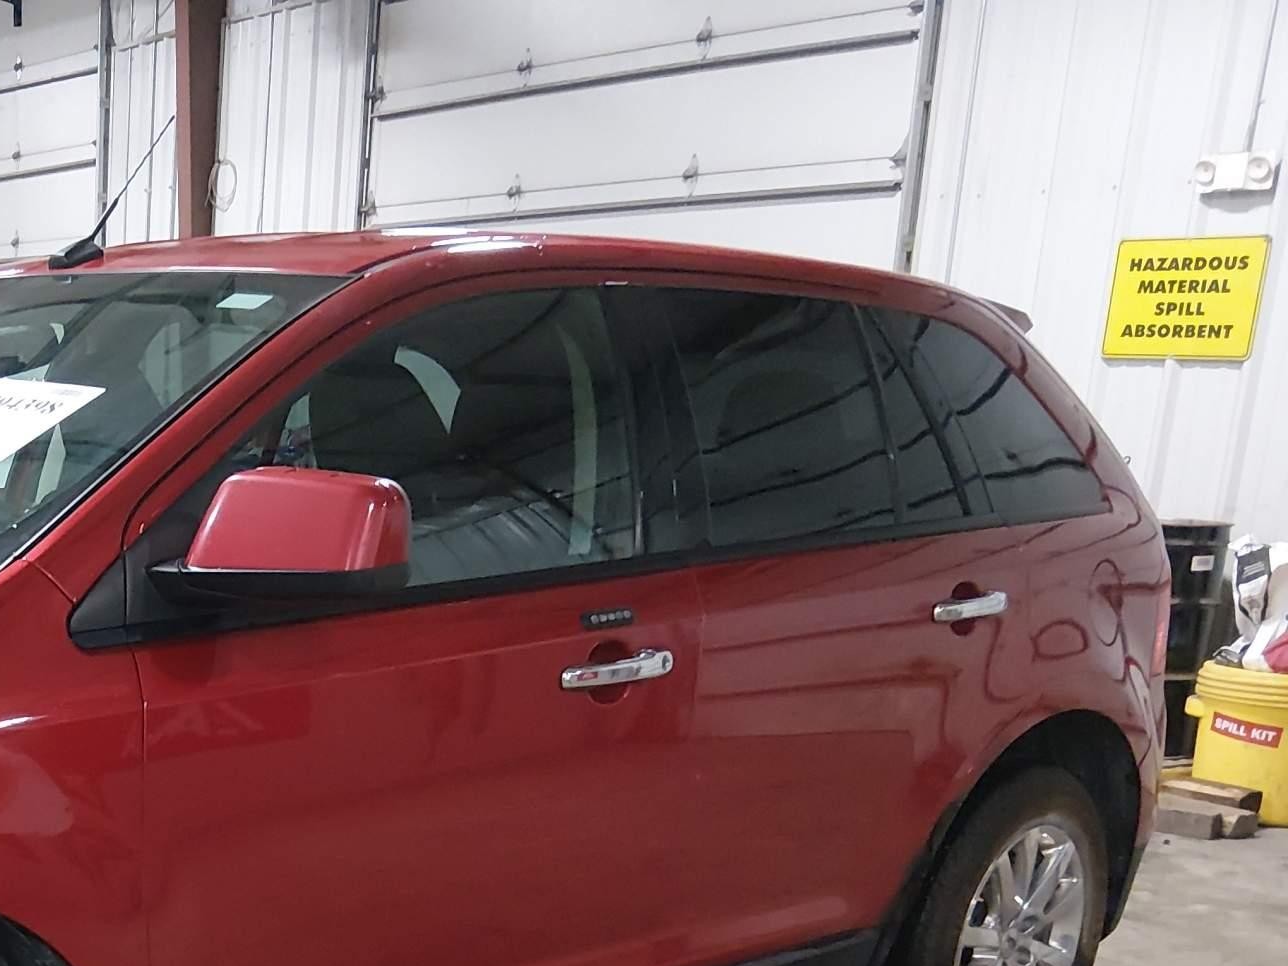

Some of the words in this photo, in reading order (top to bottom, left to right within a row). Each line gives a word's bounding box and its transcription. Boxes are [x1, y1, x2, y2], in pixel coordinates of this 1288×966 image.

[1129, 256, 1250, 272] HAZARDOUS
[1137, 279, 1231, 294] MATERIAL
[1154, 301, 1205, 316] SPILL
[1120, 324, 1234, 339] ABSORBENT
[1214, 718, 1247, 737] SPILL
[1250, 727, 1277, 743] KIT
